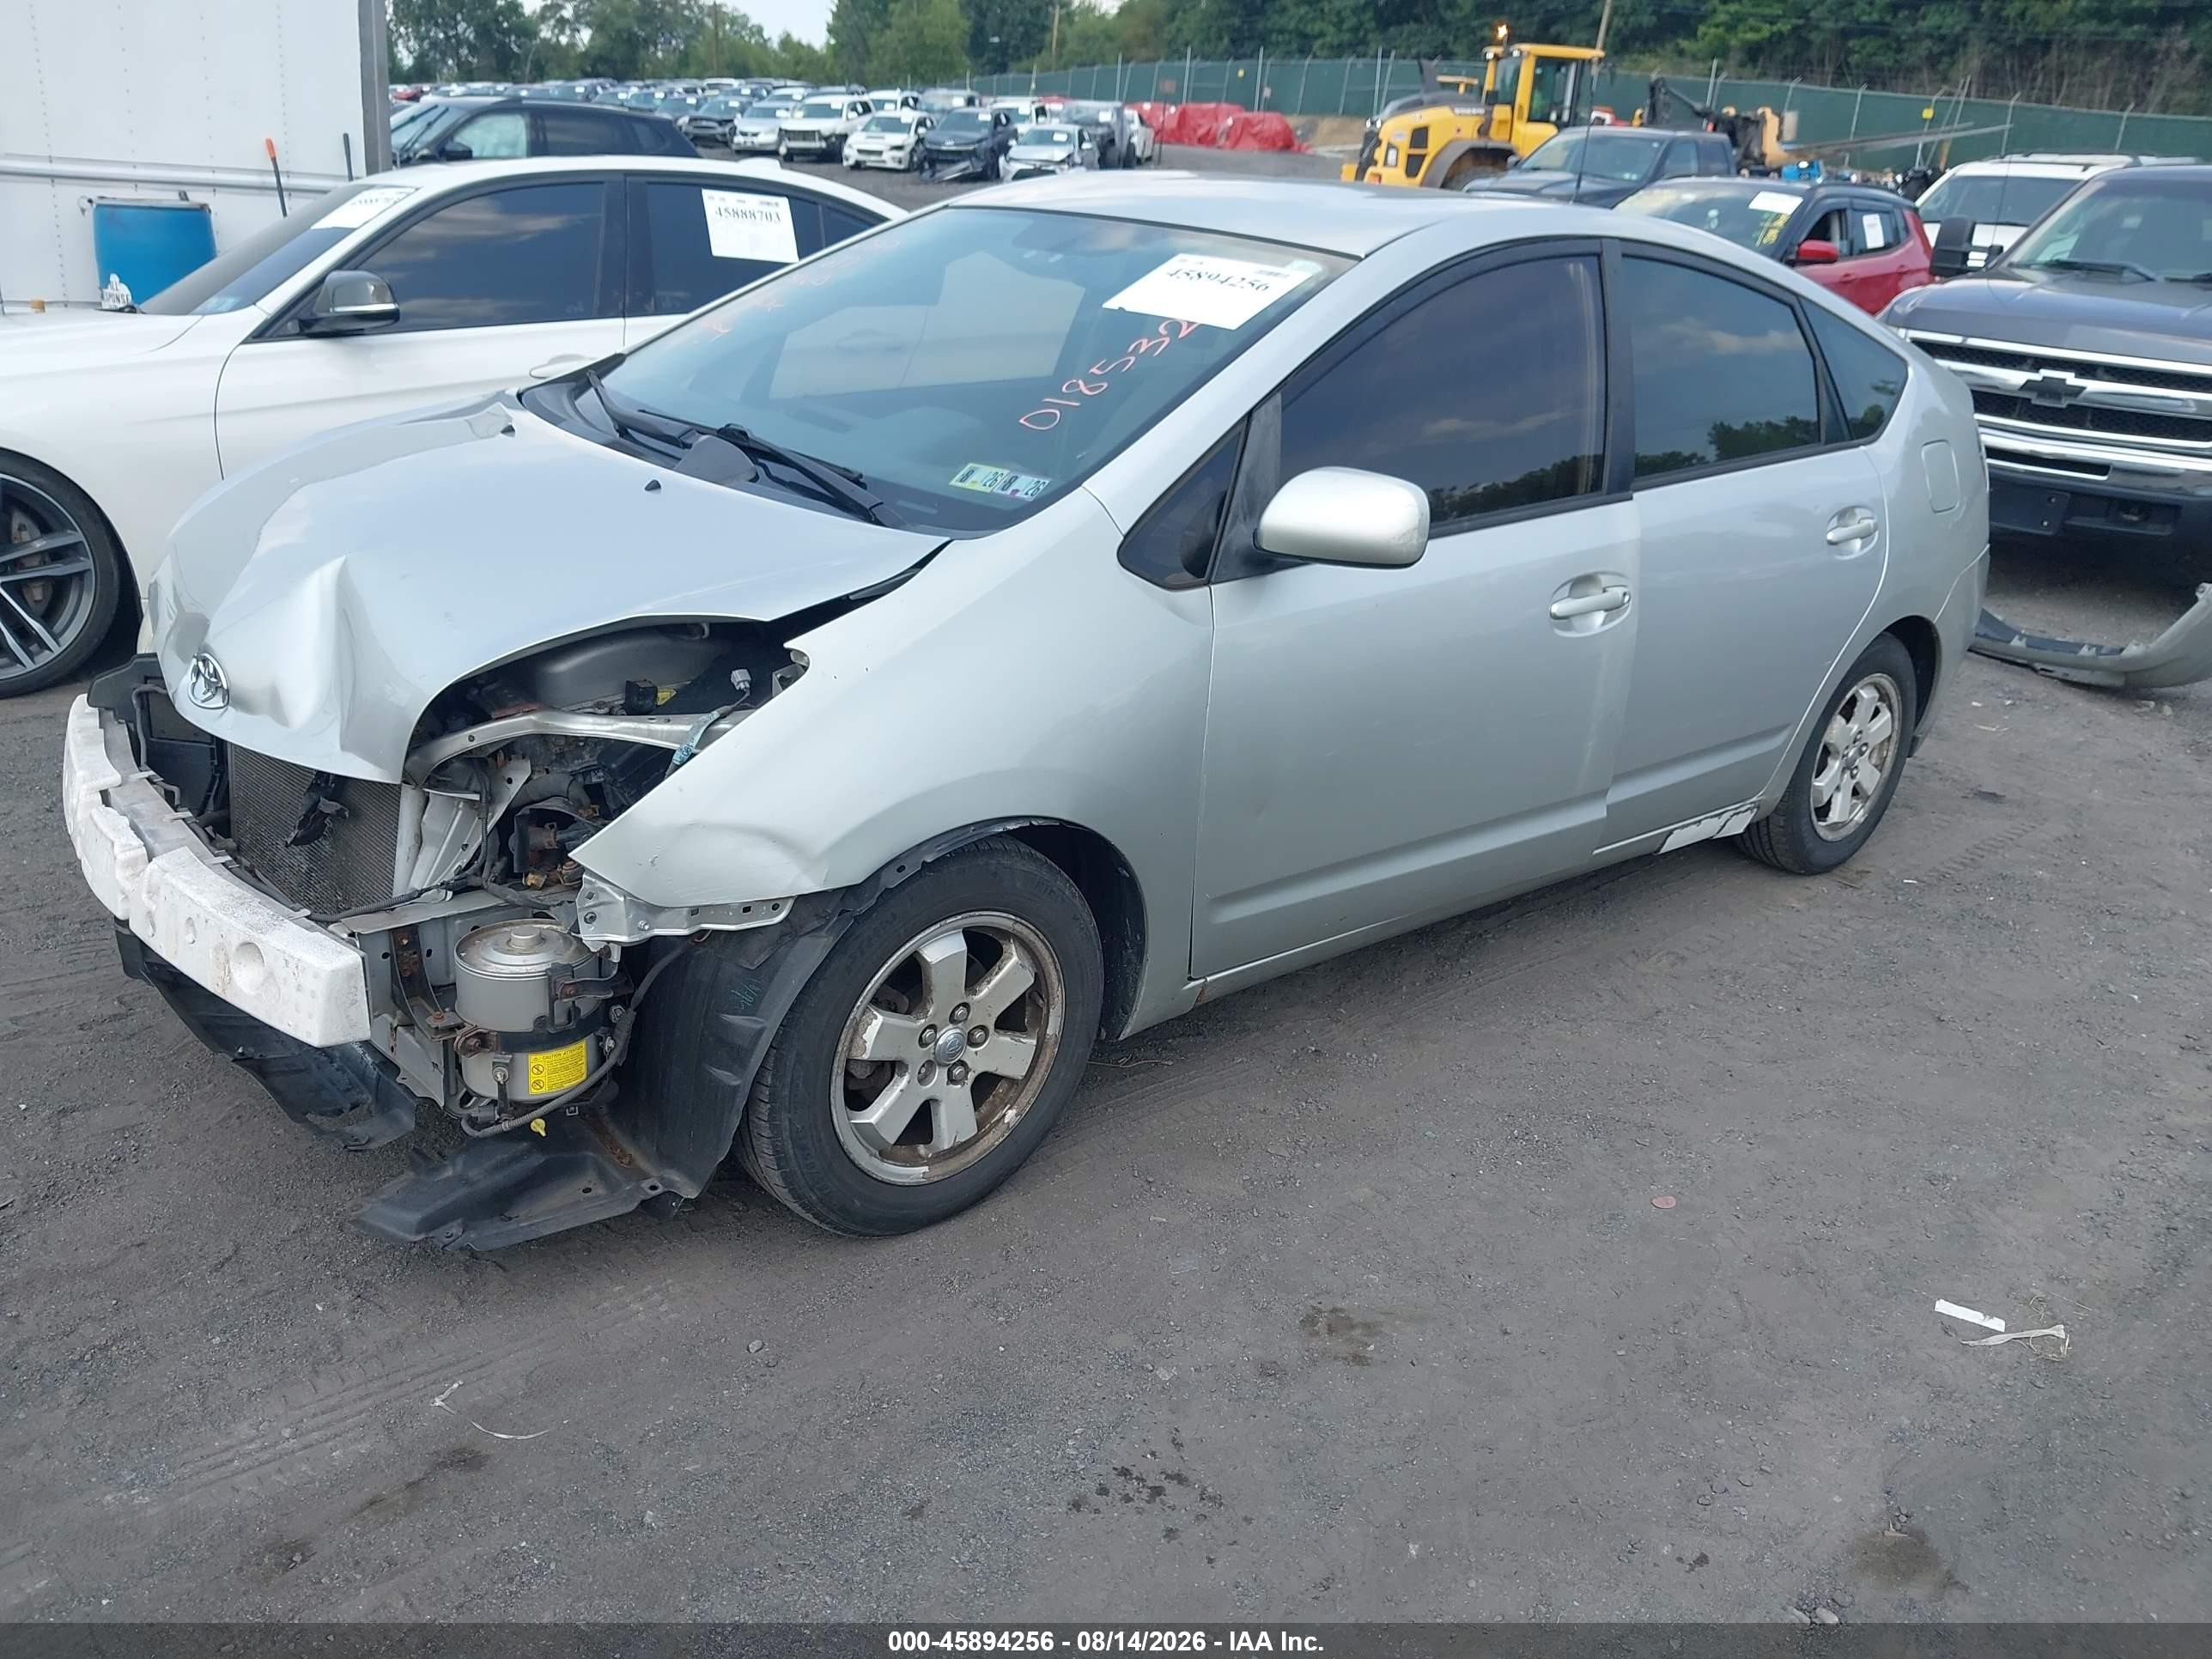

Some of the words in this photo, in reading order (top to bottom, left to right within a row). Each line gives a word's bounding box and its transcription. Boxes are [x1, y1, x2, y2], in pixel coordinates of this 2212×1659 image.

[714, 206, 782, 223] 45888703
[960, 469, 975, 483] 8
[1000, 475, 1018, 491] 8
